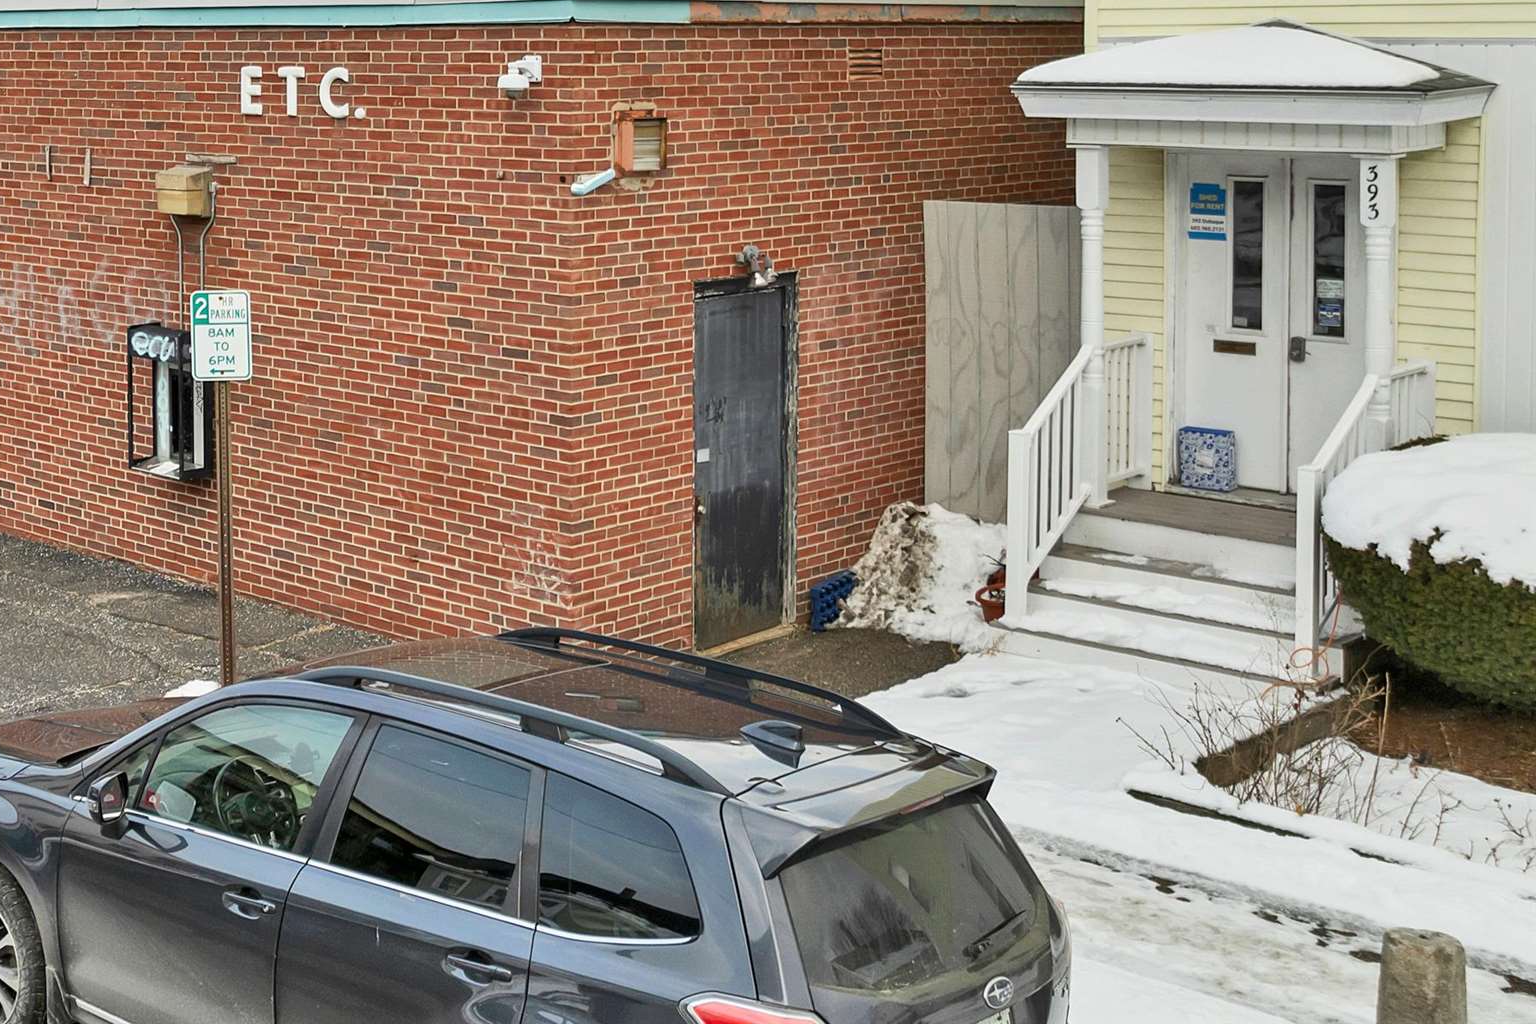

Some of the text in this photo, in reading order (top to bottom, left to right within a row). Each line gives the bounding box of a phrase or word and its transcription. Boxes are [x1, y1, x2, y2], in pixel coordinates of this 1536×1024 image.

[240, 65, 366, 120] ETC.
[1366, 165, 1380, 221] 393
[220, 296, 234, 307] HR
[195, 297, 207, 319] 2
[210, 309, 246, 320] PARKING
[208, 328, 235, 338] 8AM
[214, 341, 230, 352] TO
[208, 355, 236, 366] 6PM
